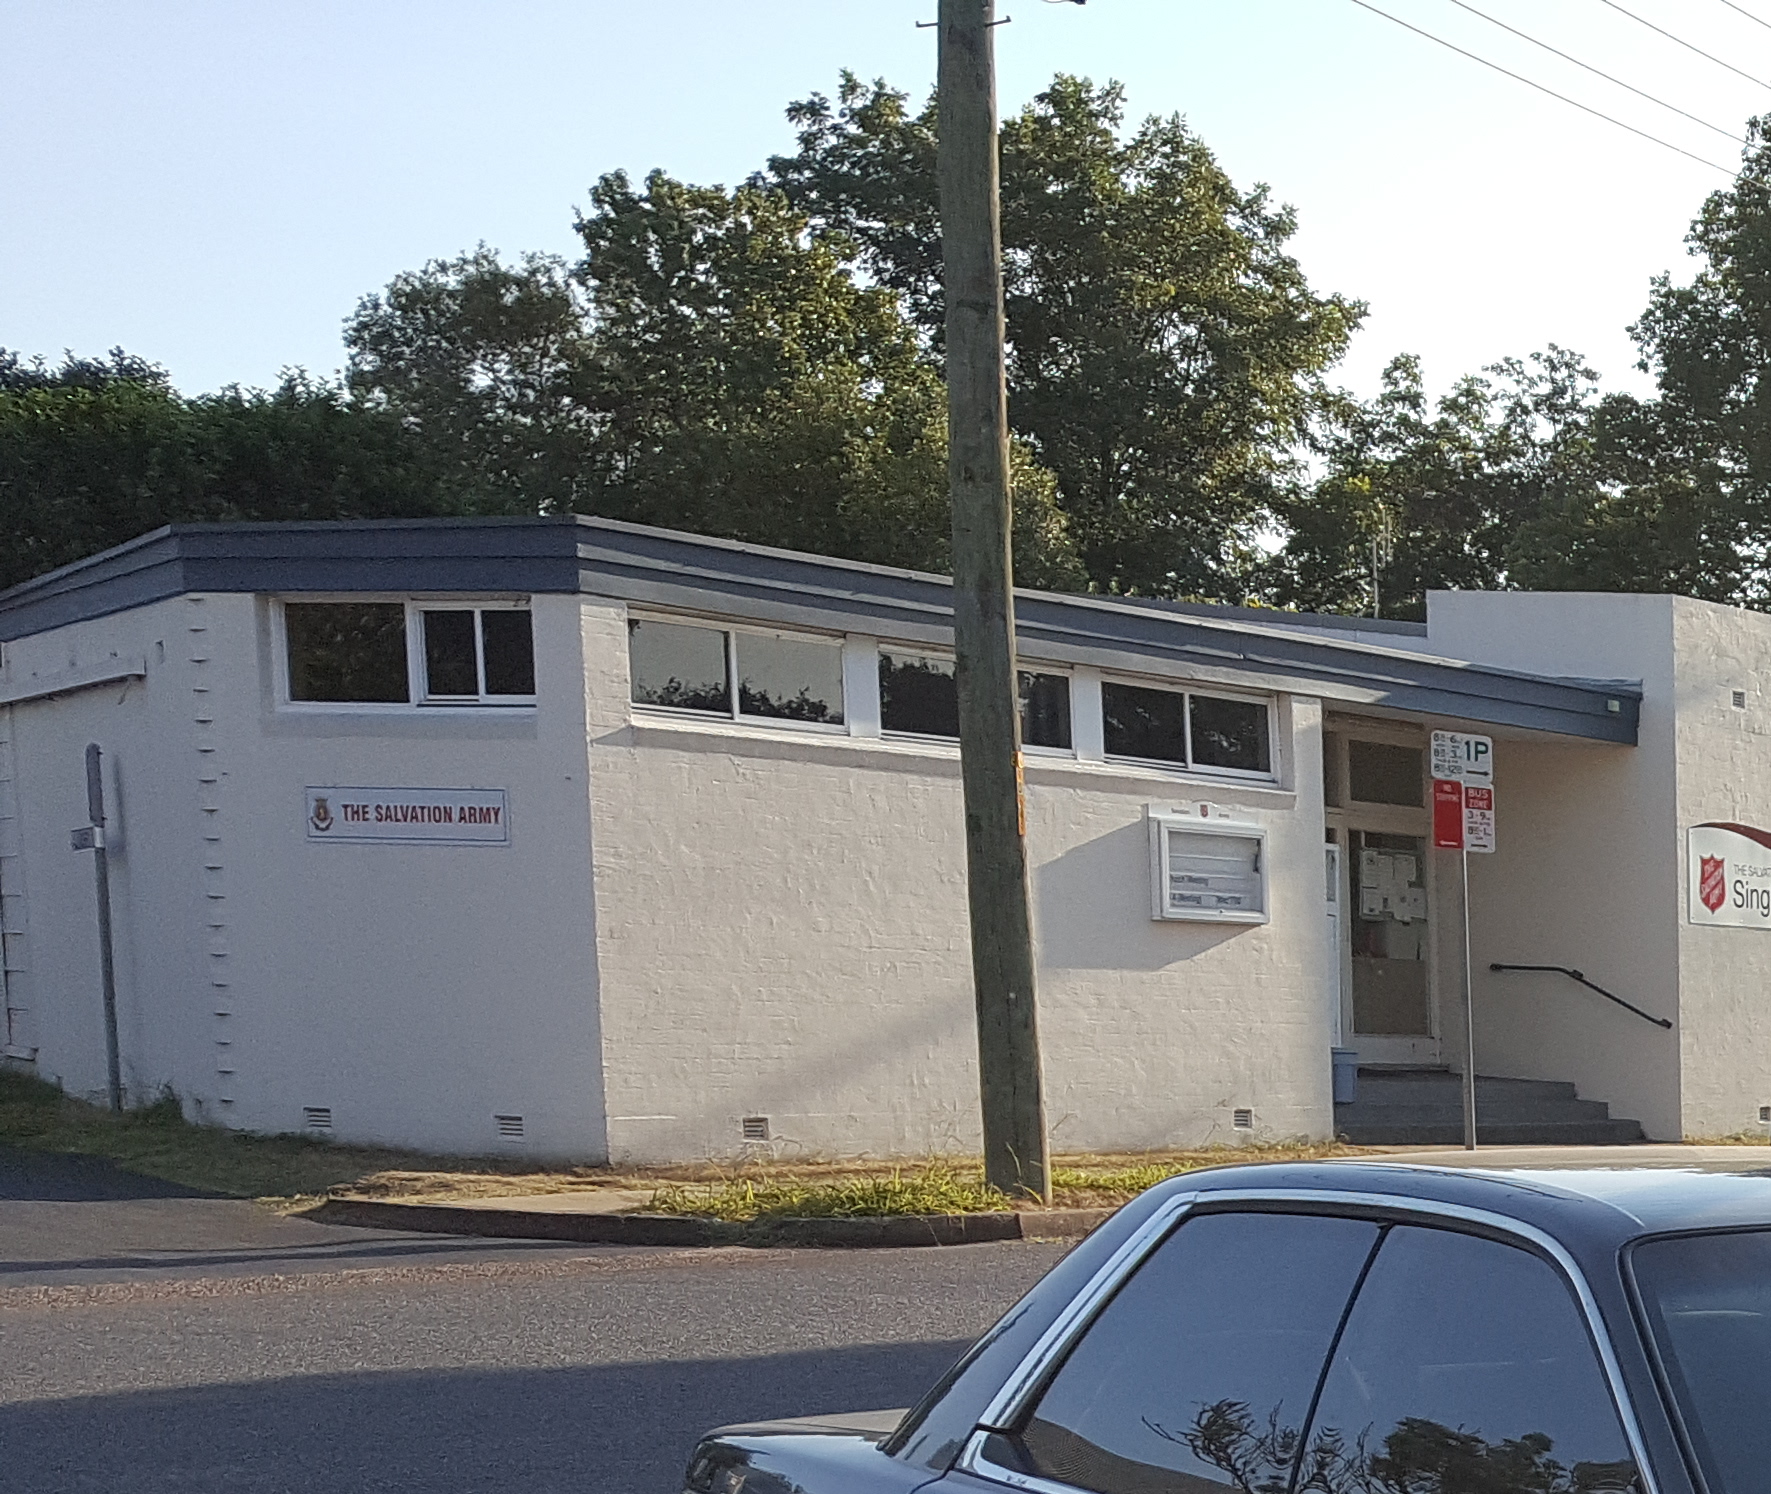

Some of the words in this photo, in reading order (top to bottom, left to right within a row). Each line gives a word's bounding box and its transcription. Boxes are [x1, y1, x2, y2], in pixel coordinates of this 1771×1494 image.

[1465, 740, 1489, 762] 1P
[1468, 788, 1489, 799] BUS
[342, 804, 370, 822] THE
[374, 804, 454, 823] SALVATION
[458, 806, 501, 824] ARMY
[1733, 864, 1747, 876] THE
